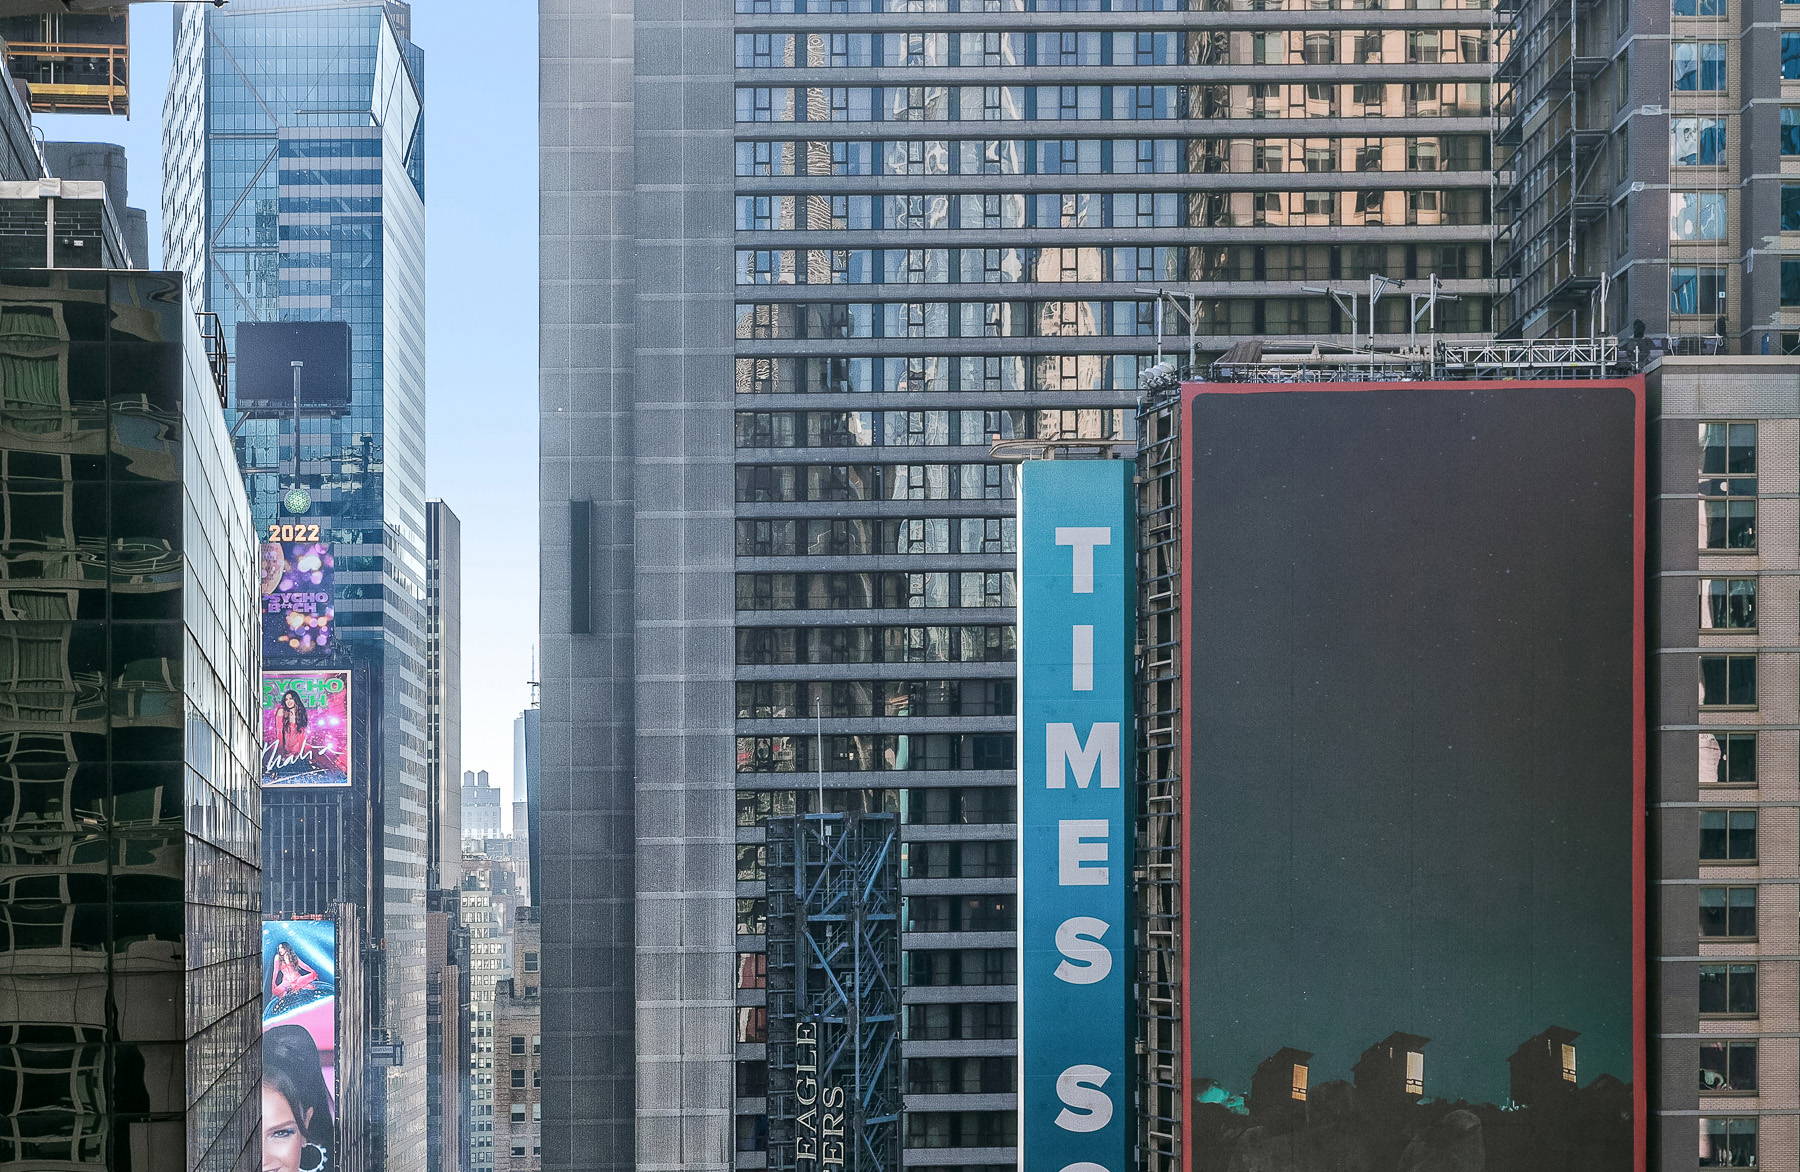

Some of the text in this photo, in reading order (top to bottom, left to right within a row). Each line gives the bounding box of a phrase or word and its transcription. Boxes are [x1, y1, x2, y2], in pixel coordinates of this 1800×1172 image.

[269, 525, 320, 542] 2022
[1045, 526, 1120, 986] TIMES
[796, 1021, 818, 1163] EAGLE
